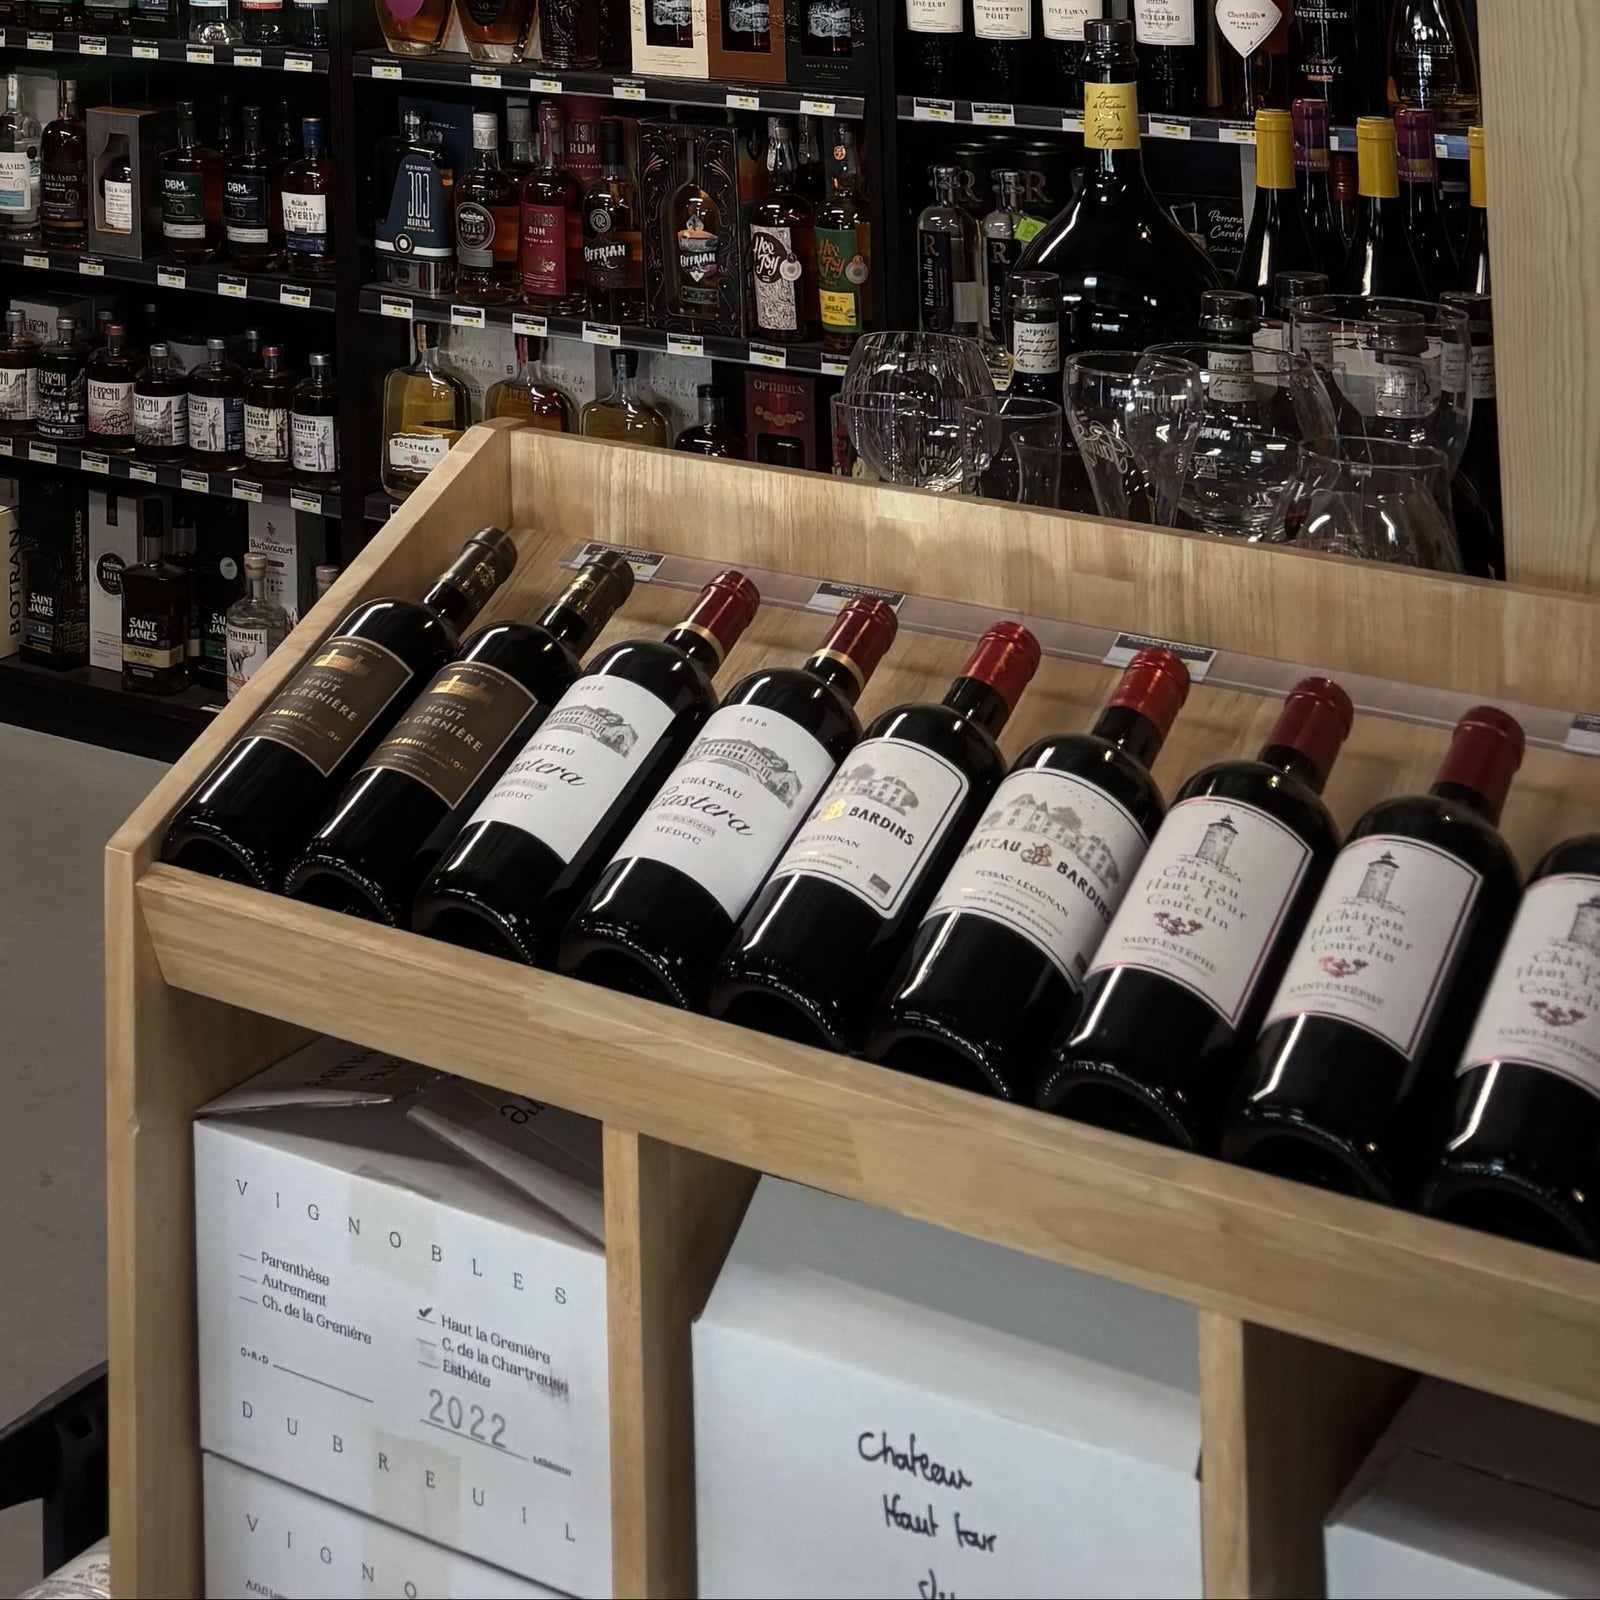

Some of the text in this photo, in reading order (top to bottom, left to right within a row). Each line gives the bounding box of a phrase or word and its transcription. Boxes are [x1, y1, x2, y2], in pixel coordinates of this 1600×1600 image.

[1300, 65, 1343, 75] RESERVE
[570, 142, 596, 155] RUM
[164, 178, 185, 191] DBM
[227, 182, 247, 194] DBM
[1208, 209, 1243, 224] Pomme
[9, 528, 21, 636] BOTRAN
[28, 603, 54, 618] JAMES
[31, 592, 53, 605] SAINT
[127, 628, 158, 642] JAMES
[129, 616, 157, 632] SAINT
[303, 677, 341, 693] HAUT
[291, 687, 357, 723] GRENIÈRE
[426, 703, 465, 721] HAUT
[413, 714, 483, 753] GRENIÈRE
[739, 715, 767, 728] 2016
[508, 757, 586, 788] stera
[681, 776, 742, 800] CHÂTEAU
[650, 785, 754, 837] Castera
[848, 806, 914, 846] BARDINS
[654, 826, 701, 846] MÉDOC
[1056, 861, 1113, 925] BARDINS
[1162, 865, 1240, 899] Château
[1146, 878, 1248, 921] Haut Tour
[1147, 894, 1230, 931] Coutelin
[1326, 909, 1404, 933] Château
[1311, 923, 1414, 952] Haut Tour
[1311, 939, 1396, 964] Coutelin
[236, 1178, 568, 1306] VIGNOBLES
[260, 1251, 330, 1287] Parenthèse
[261, 1274, 328, 1308] Autrement
[261, 1294, 373, 1346] Ch. de la Grenière
[441, 1314, 551, 1366] Haut la Grenière
[441, 1336, 570, 1396] C. de la Chartreuse
[442, 1359, 492, 1389] Esthète
[427, 1388, 507, 1450] 2022
[241, 1400, 576, 1543] DUBREUIL
[857, 1430, 973, 1490] Chateau
[883, 1493, 939, 1537] Haut
